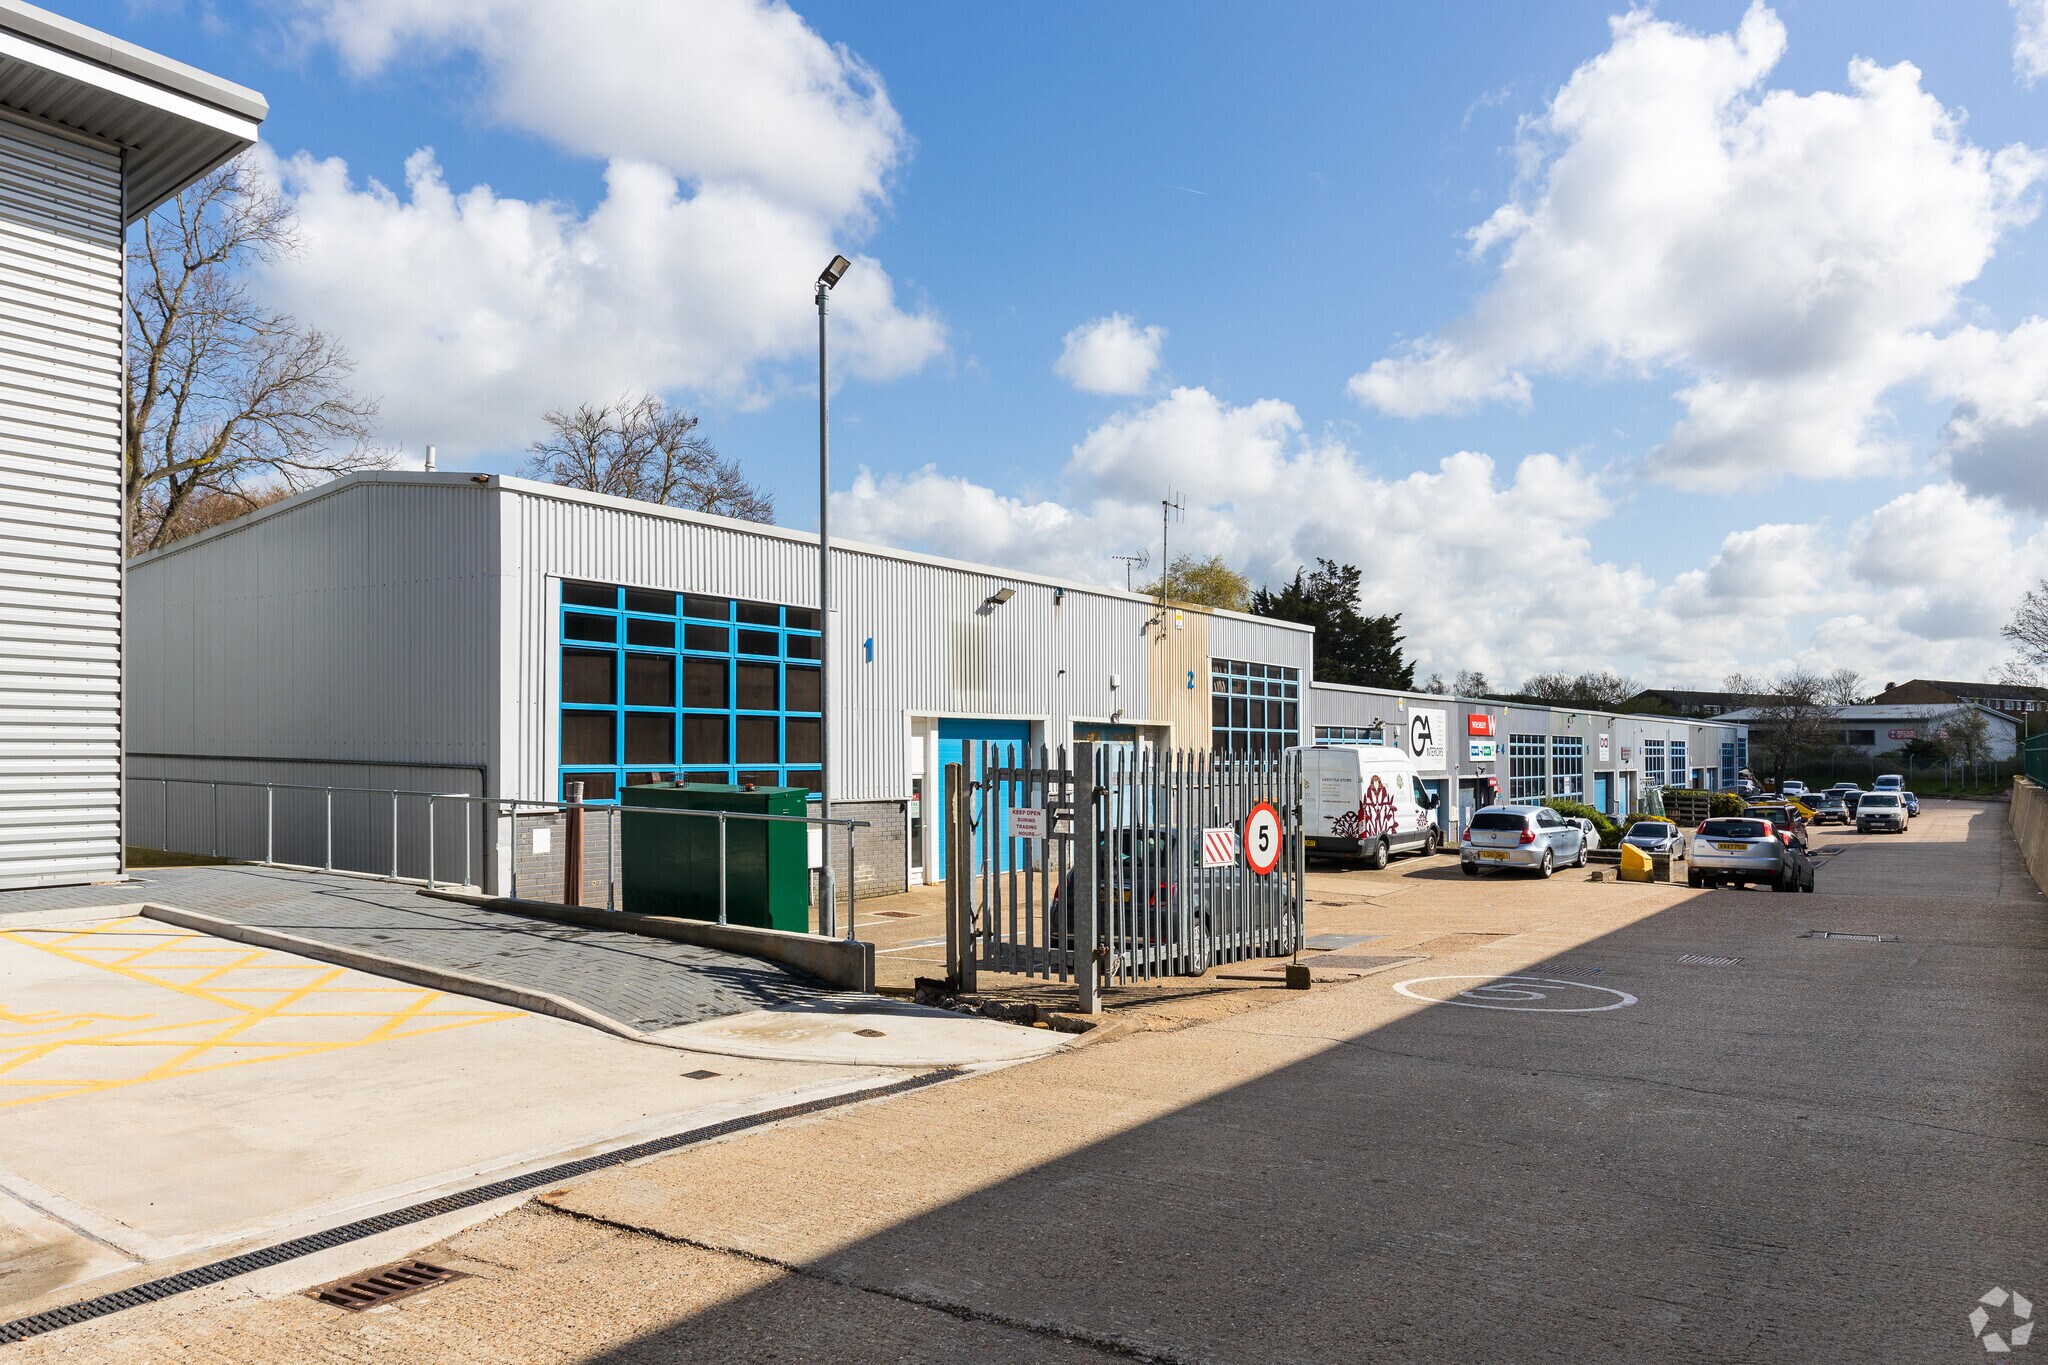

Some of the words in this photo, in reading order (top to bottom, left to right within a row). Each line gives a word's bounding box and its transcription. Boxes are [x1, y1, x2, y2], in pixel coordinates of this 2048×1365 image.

[864, 637, 874, 663] 1
[1187, 671, 1195, 689] 2
[1411, 715, 1433, 757] GA
[1259, 825, 1269, 852] 5
